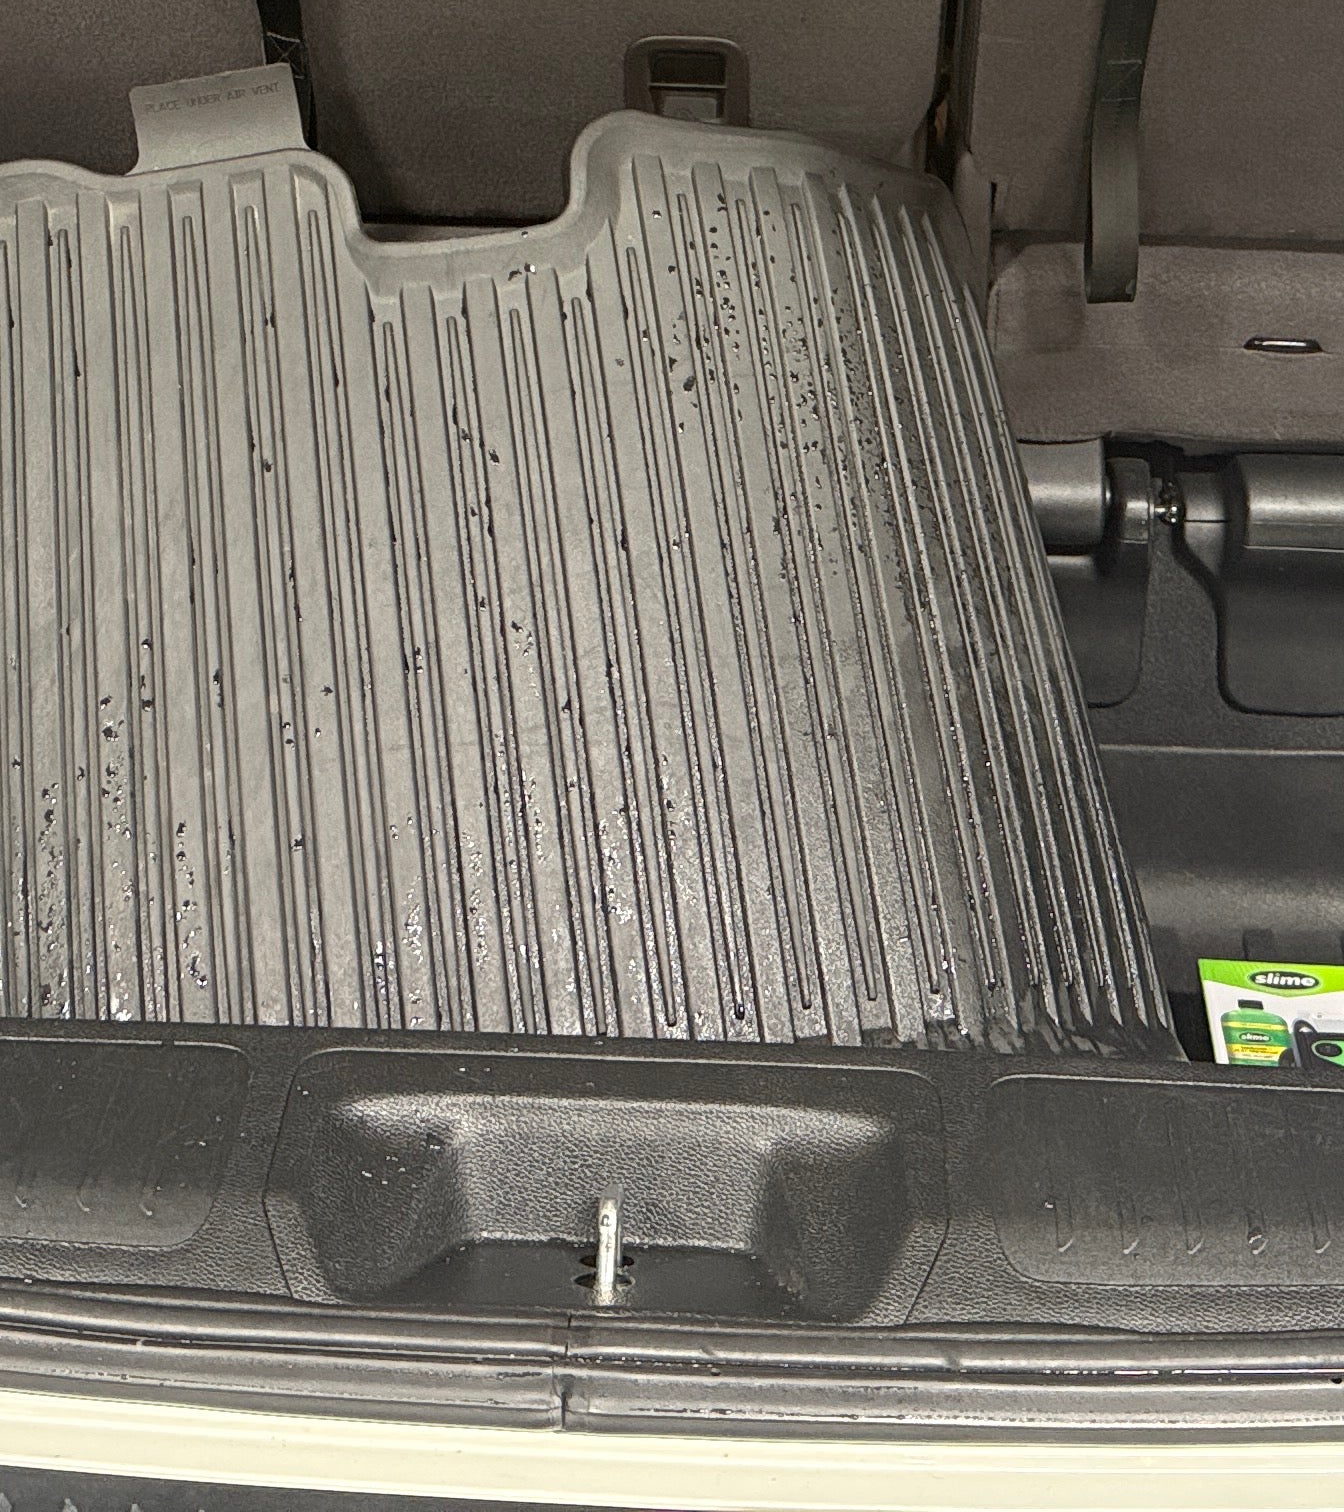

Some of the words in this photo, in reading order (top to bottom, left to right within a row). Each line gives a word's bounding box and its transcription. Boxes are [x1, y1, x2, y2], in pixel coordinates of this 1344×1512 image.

[145, 99, 181, 113] PLACE
[186, 93, 221, 108] UNDER
[226, 88, 247, 101] AIR
[251, 81, 280, 96] VENT
[1255, 972, 1316, 987] slime
